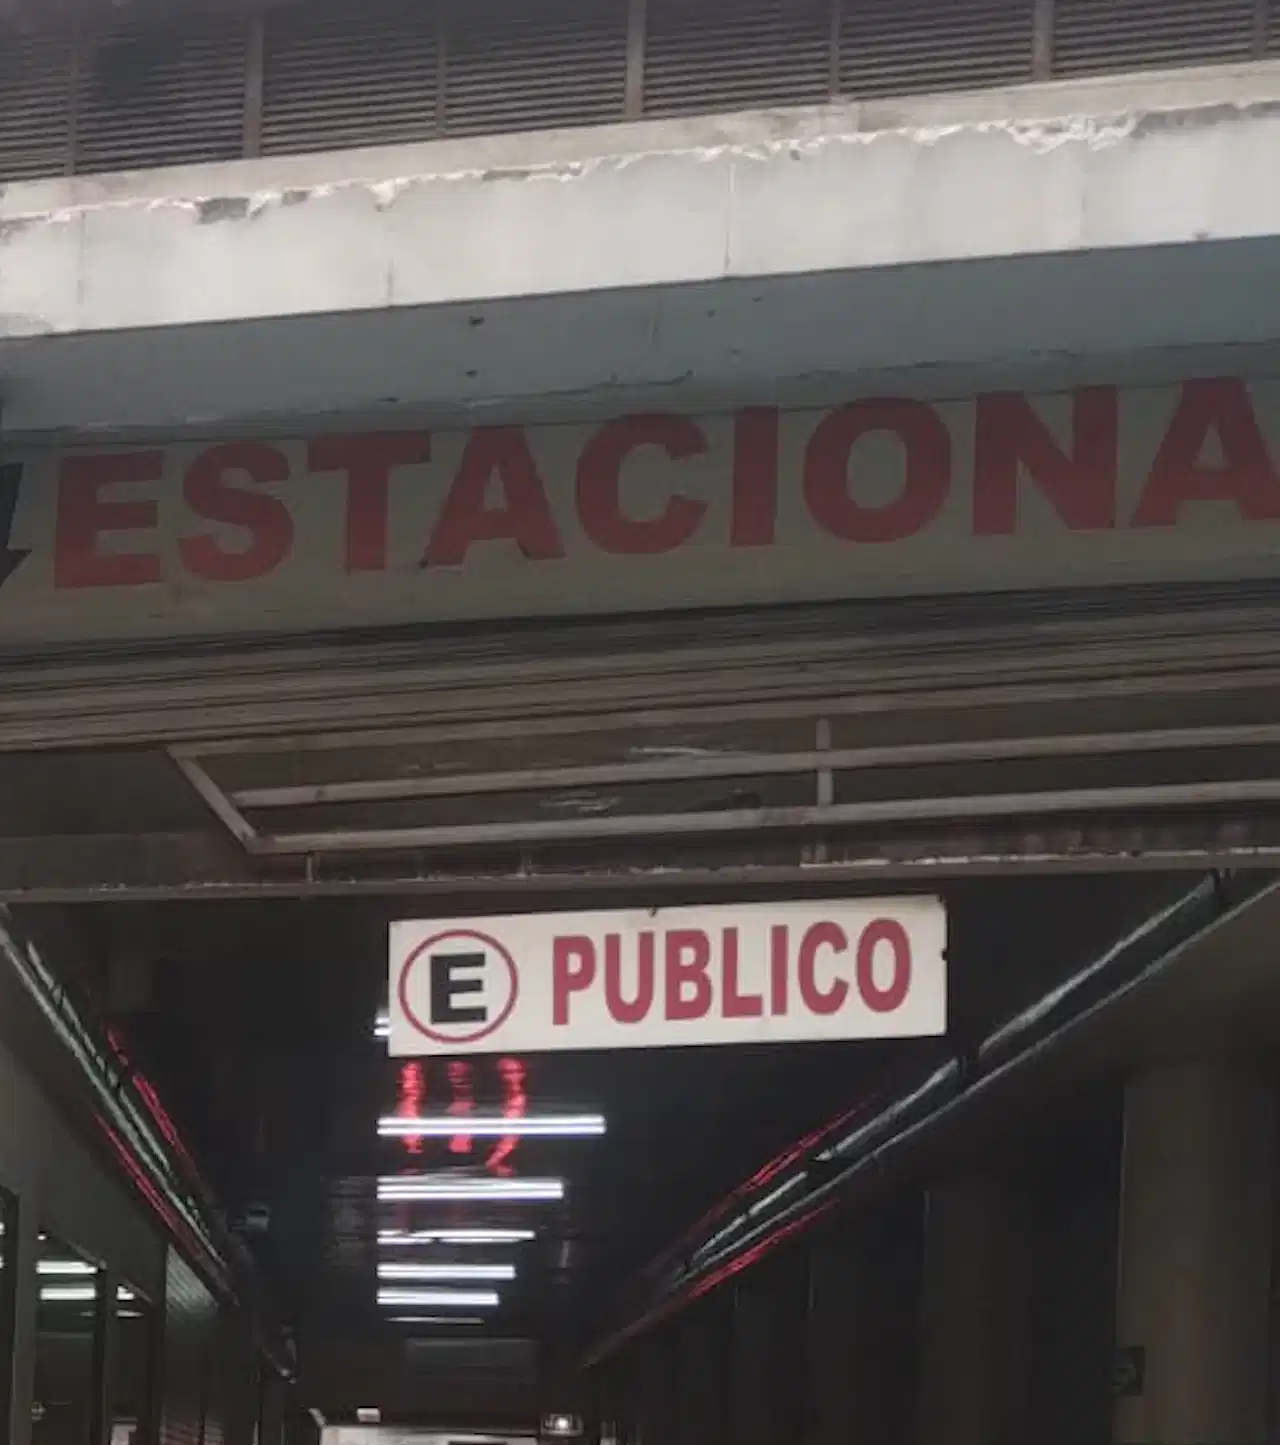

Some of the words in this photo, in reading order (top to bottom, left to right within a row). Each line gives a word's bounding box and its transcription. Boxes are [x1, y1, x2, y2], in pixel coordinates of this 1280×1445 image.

[53, 376, 1280, 589] ESTACIONA
[429, 951, 487, 1025] E
[552, 919, 912, 1026] PUBLICO
